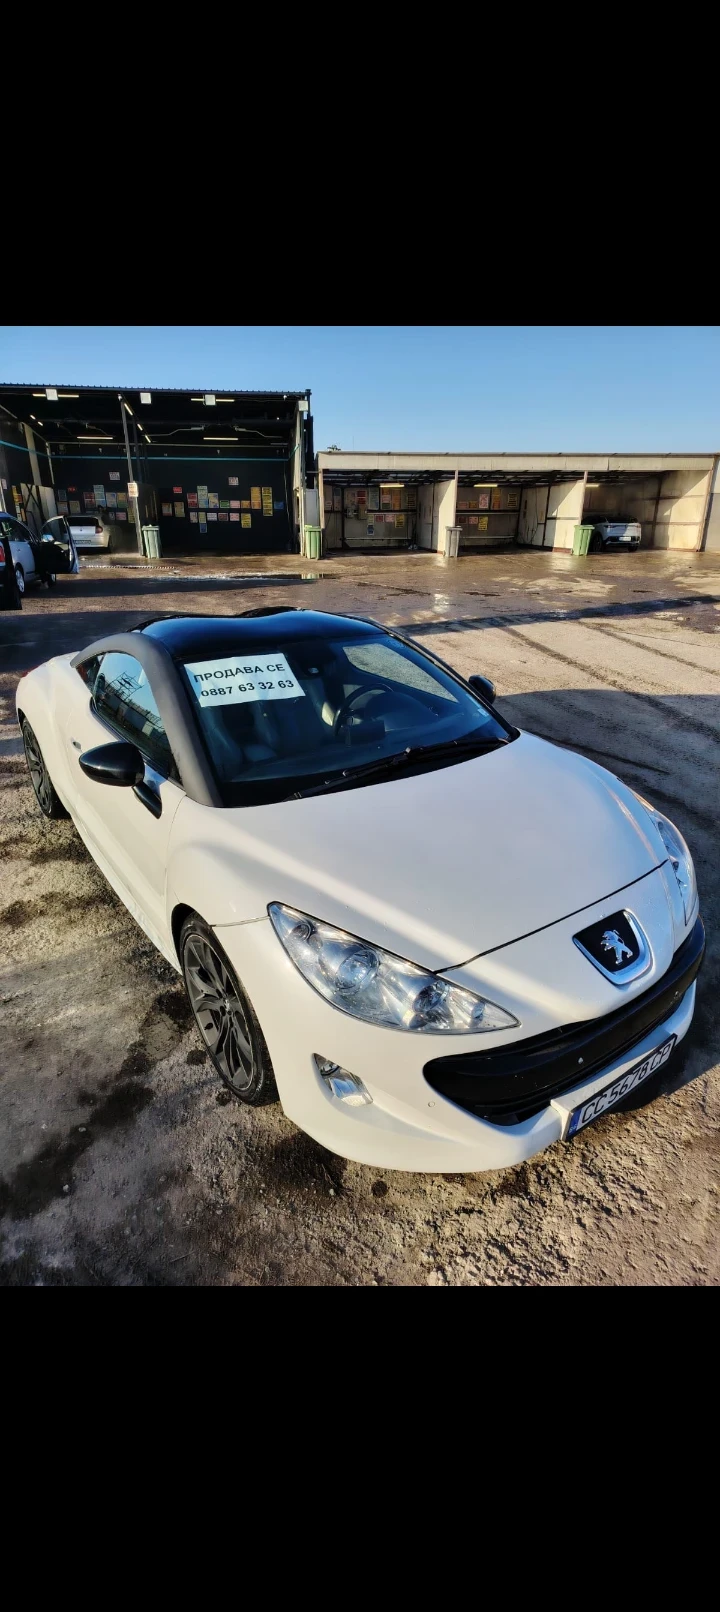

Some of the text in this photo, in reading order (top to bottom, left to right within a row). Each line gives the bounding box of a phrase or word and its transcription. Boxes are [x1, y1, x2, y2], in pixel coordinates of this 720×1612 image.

[194, 663, 285, 682] ПРОДАВА СЕ
[201, 680, 294, 697] 0887 63 32 63
[582, 1043, 671, 1124] CC 5678 CP
